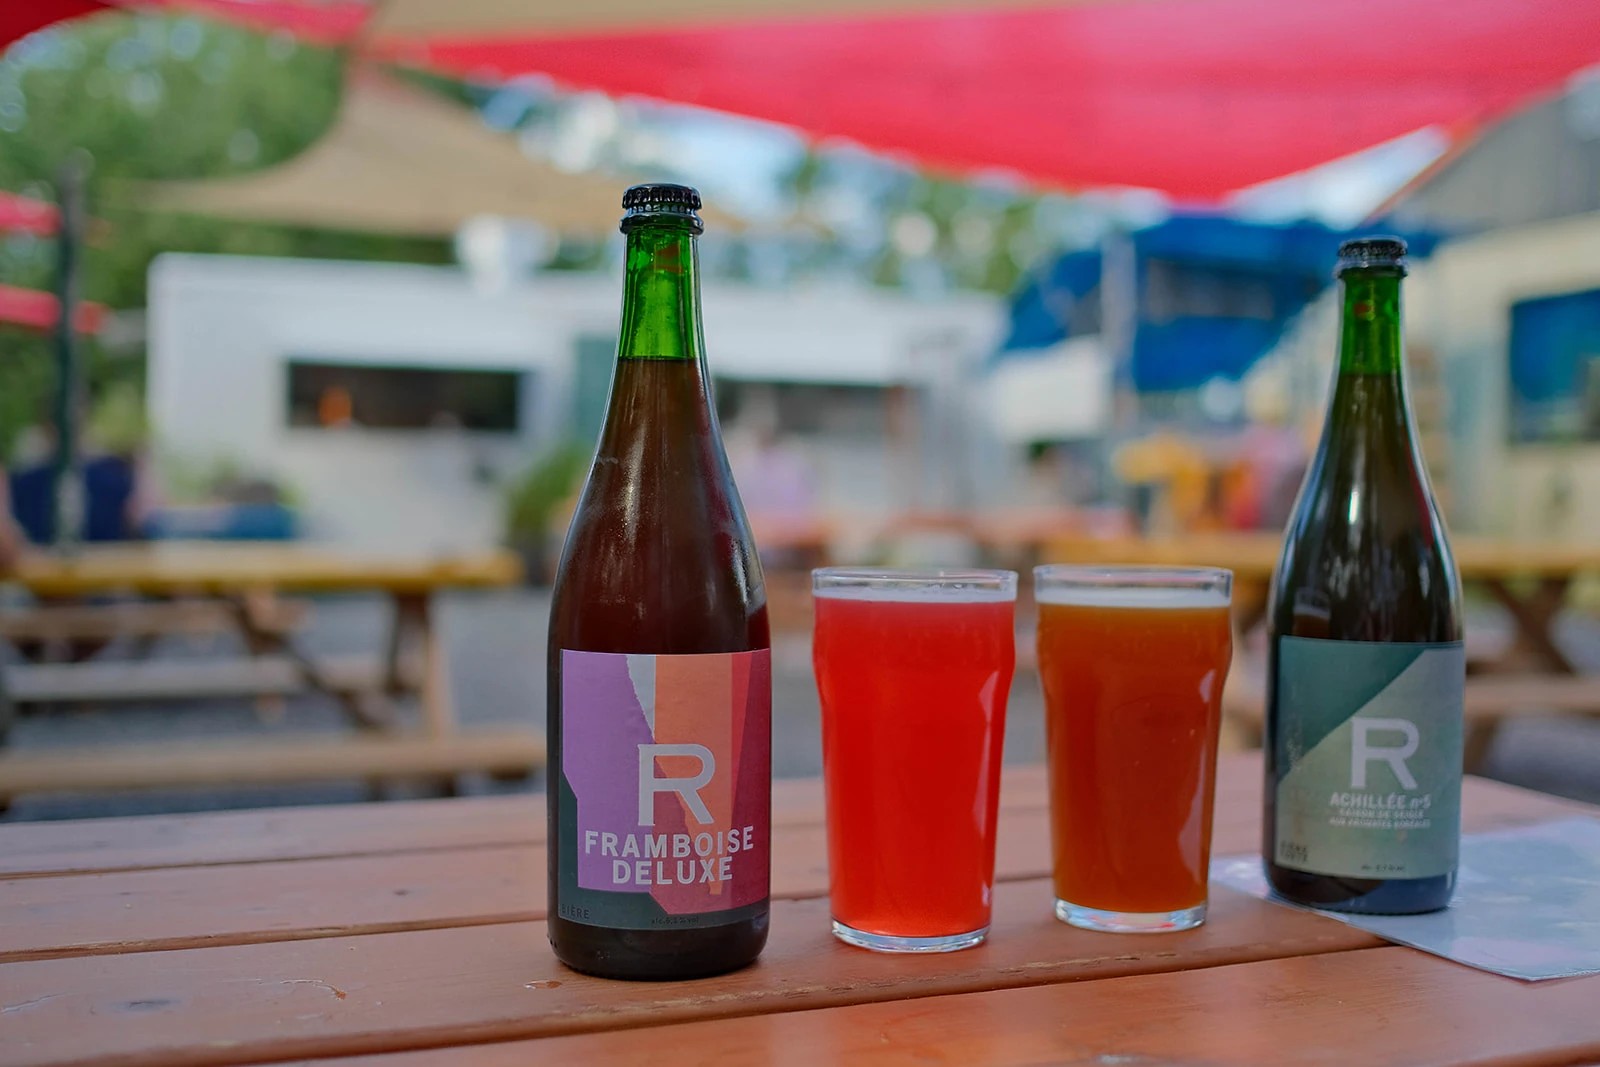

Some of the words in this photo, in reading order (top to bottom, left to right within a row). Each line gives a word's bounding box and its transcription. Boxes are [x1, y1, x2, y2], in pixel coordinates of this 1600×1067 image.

[1351, 716, 1420, 790] R
[637, 743, 716, 826] R
[1329, 791, 1407, 809] ACHILLÉE
[585, 825, 754, 858] FRAMBOISE
[612, 856, 733, 885] DELUXE
[561, 902, 590, 920] BIÈRE
